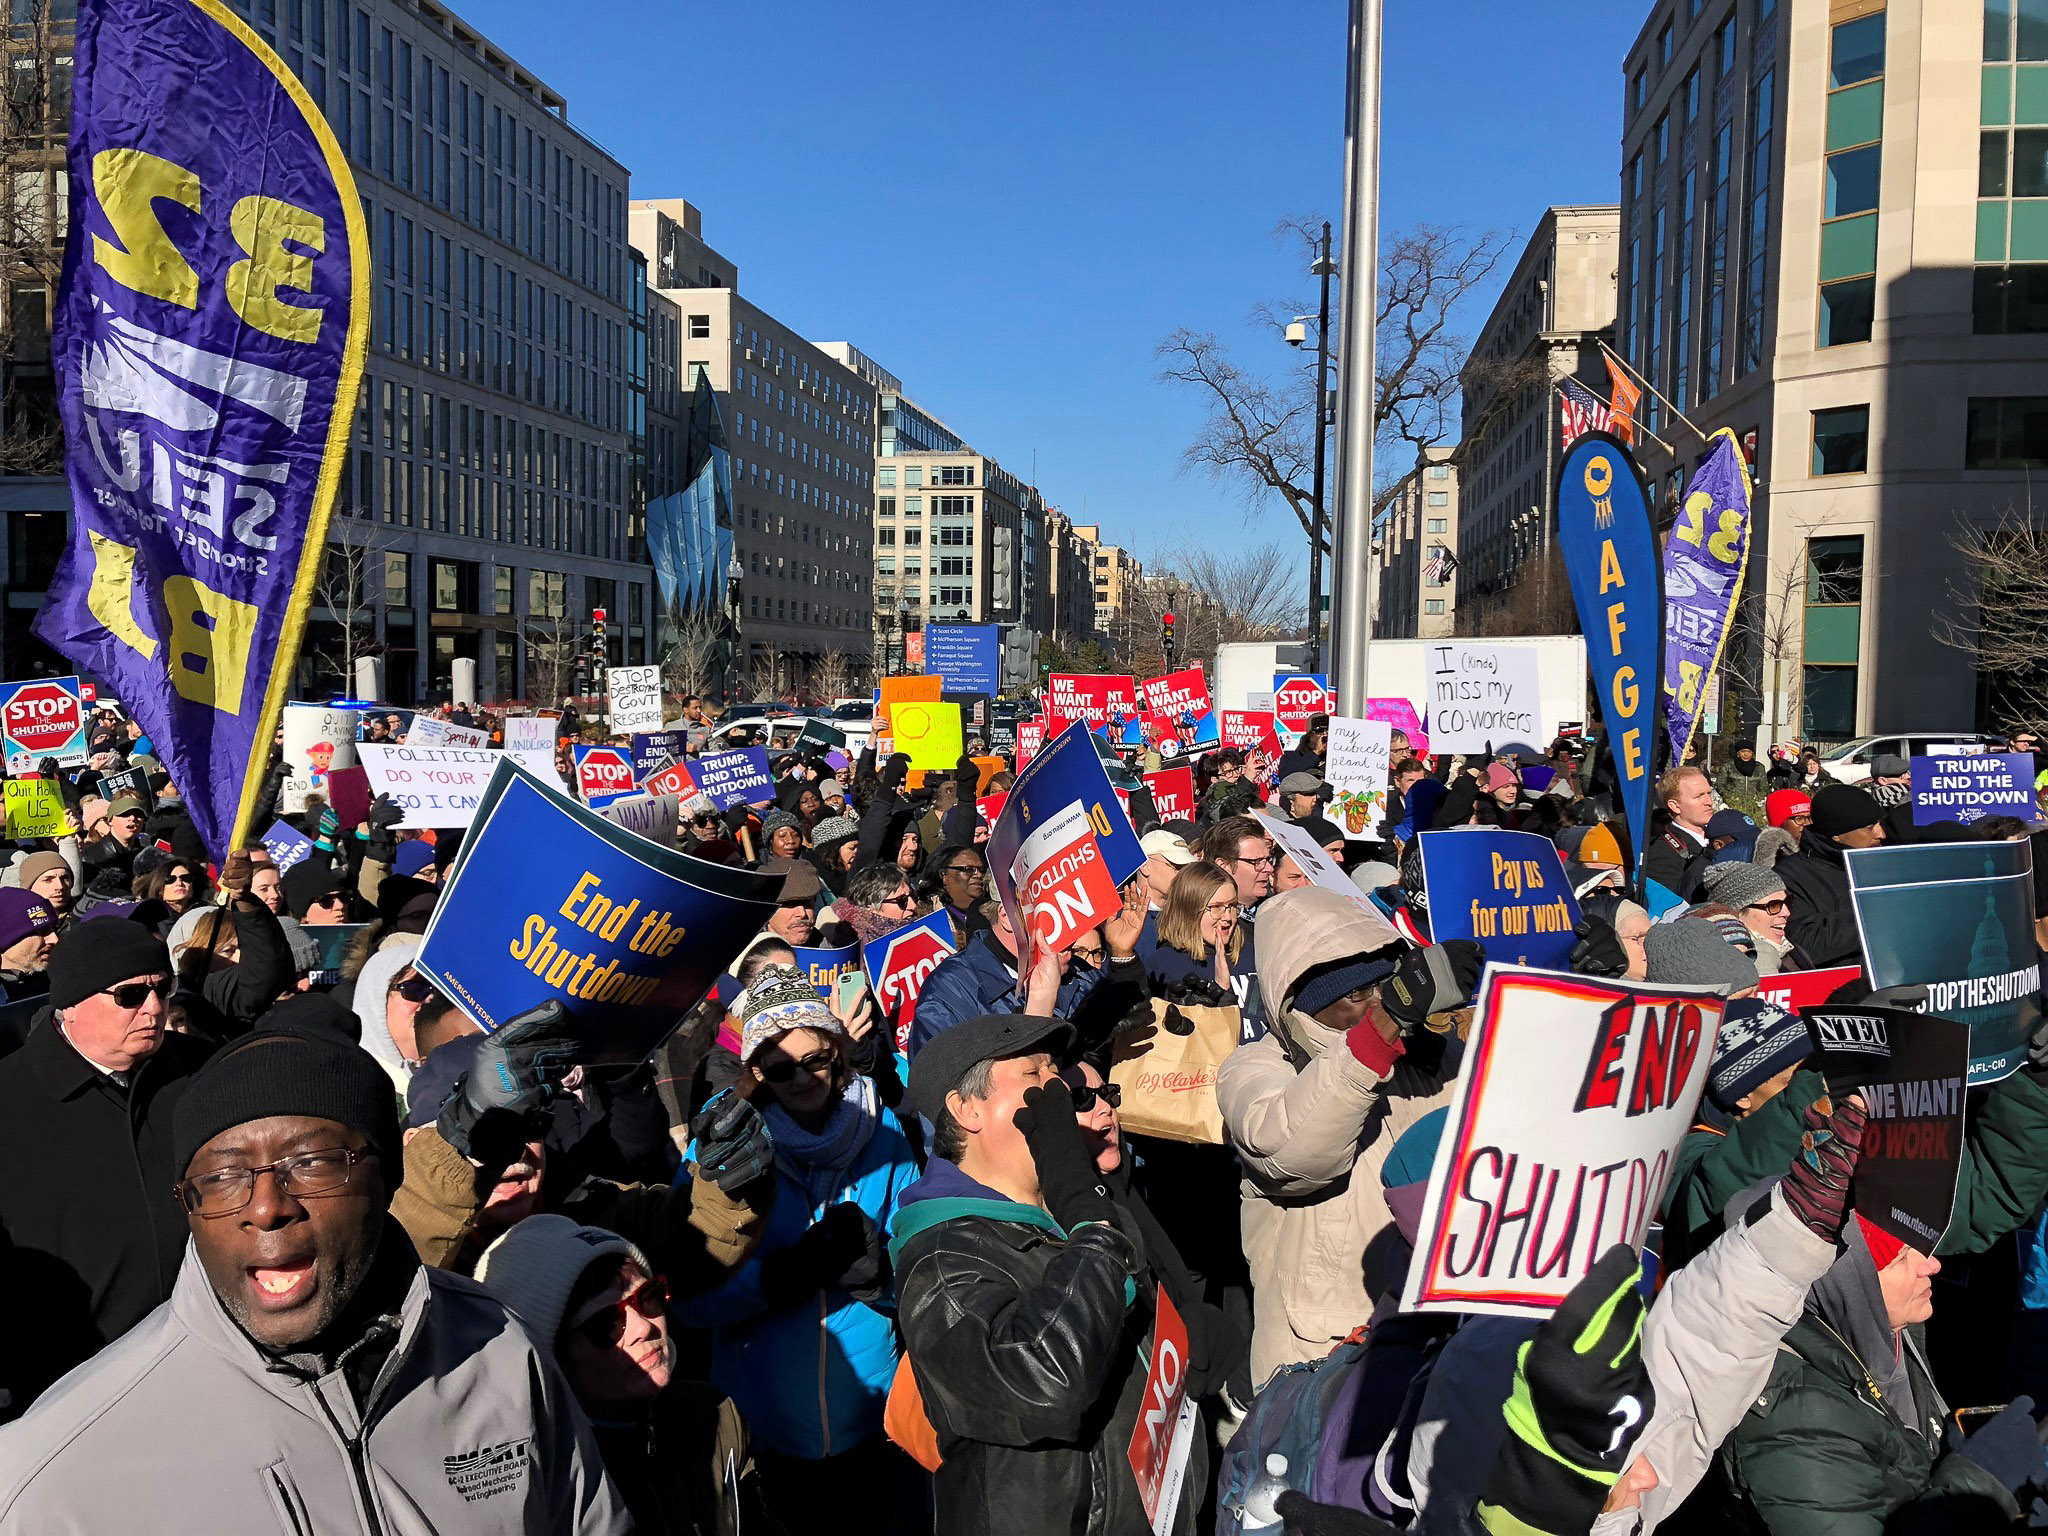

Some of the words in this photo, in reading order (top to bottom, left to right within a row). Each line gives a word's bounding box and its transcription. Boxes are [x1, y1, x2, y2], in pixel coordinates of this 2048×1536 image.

[908, 640, 922, 655] 16
[1434, 646, 1455, 674] I
[1600, 539, 1644, 781] AFGE
[611, 668, 654, 685] STOP
[1053, 679, 1075, 692] WE
[1146, 680, 1169, 695] WE
[1437, 677, 1481, 702] miss
[1487, 681, 1512, 704] my
[1053, 693, 1094, 706] WANT
[1107, 690, 1123, 702] NT
[1149, 688, 1190, 708] WANT
[1279, 690, 1322, 705] STOP
[10, 696, 73, 720] STOP
[1053, 706, 1063, 716] TO
[1064, 707, 1105, 720] WORK
[1152, 707, 1164, 718] TO
[1162, 697, 1208, 718] WORK
[34, 716, 51, 725] THE
[612, 710, 661, 728] RESEARCH
[1225, 713, 1244, 724] WE
[12, 720, 75, 736] SHUTDOWN
[1021, 727, 1041, 738] WE
[1225, 724, 1260, 735] WANT
[505, 740, 553, 750] LANDLORD
[1188, 740, 1219, 751] MACHINISTS
[1225, 735, 1234, 743] TO
[645, 747, 667, 757] END
[1333, 742, 1388, 757] cubicle
[701, 754, 749, 772] TRUMP:
[1331, 756, 1370, 770] plant
[1935, 759, 2006, 773] TRUMP:
[385, 770, 412, 782] DO
[422, 771, 476, 785] YOUR
[582, 763, 630, 781] STOP
[701, 770, 730, 786] END
[732, 764, 756, 777] THE
[1329, 771, 1376, 788] dying
[286, 780, 308, 791] END
[654, 774, 680, 793] NO
[1932, 776, 1971, 789] END
[1975, 775, 2013, 789] THE
[396, 794, 421, 809] SO
[425, 794, 443, 809] I
[1918, 791, 2028, 806] SHUTDOWN
[28, 798, 50, 818] US
[616, 800, 656, 832] WANT
[661, 799, 670, 826] A
[9, 822, 59, 838] Hostage
[1042, 812, 1082, 841] www.nteu.org
[1491, 852, 1521, 898] Pay
[1524, 860, 1544, 888] us
[558, 870, 641, 943] End
[629, 909, 686, 958] the
[1471, 898, 1498, 938] for
[1502, 905, 1530, 935] our
[1533, 895, 1573, 933] work
[509, 913, 660, 1005] Shutdown
[810, 963, 838, 986] End
[443, 971, 476, 1008] AMERICAN
[1814, 1017, 1888, 1046] NTEU
[1572, 994, 1703, 1118] END
[1968, 1058, 2006, 1075] AFL-CIO
[1161, 1069, 1217, 1089] Clarke's
[1858, 1083, 1896, 1118] WE
[1898, 1078, 1961, 1117] WANT
[1886, 1121, 1952, 1160] WORK
[1145, 1338, 1180, 1455] NO
[465, 1466, 503, 1483] EXECUTIVE
[503, 1458, 529, 1471] BOARD
[482, 1470, 523, 1488] Mechanical
[477, 1483, 517, 1500] Engineering
